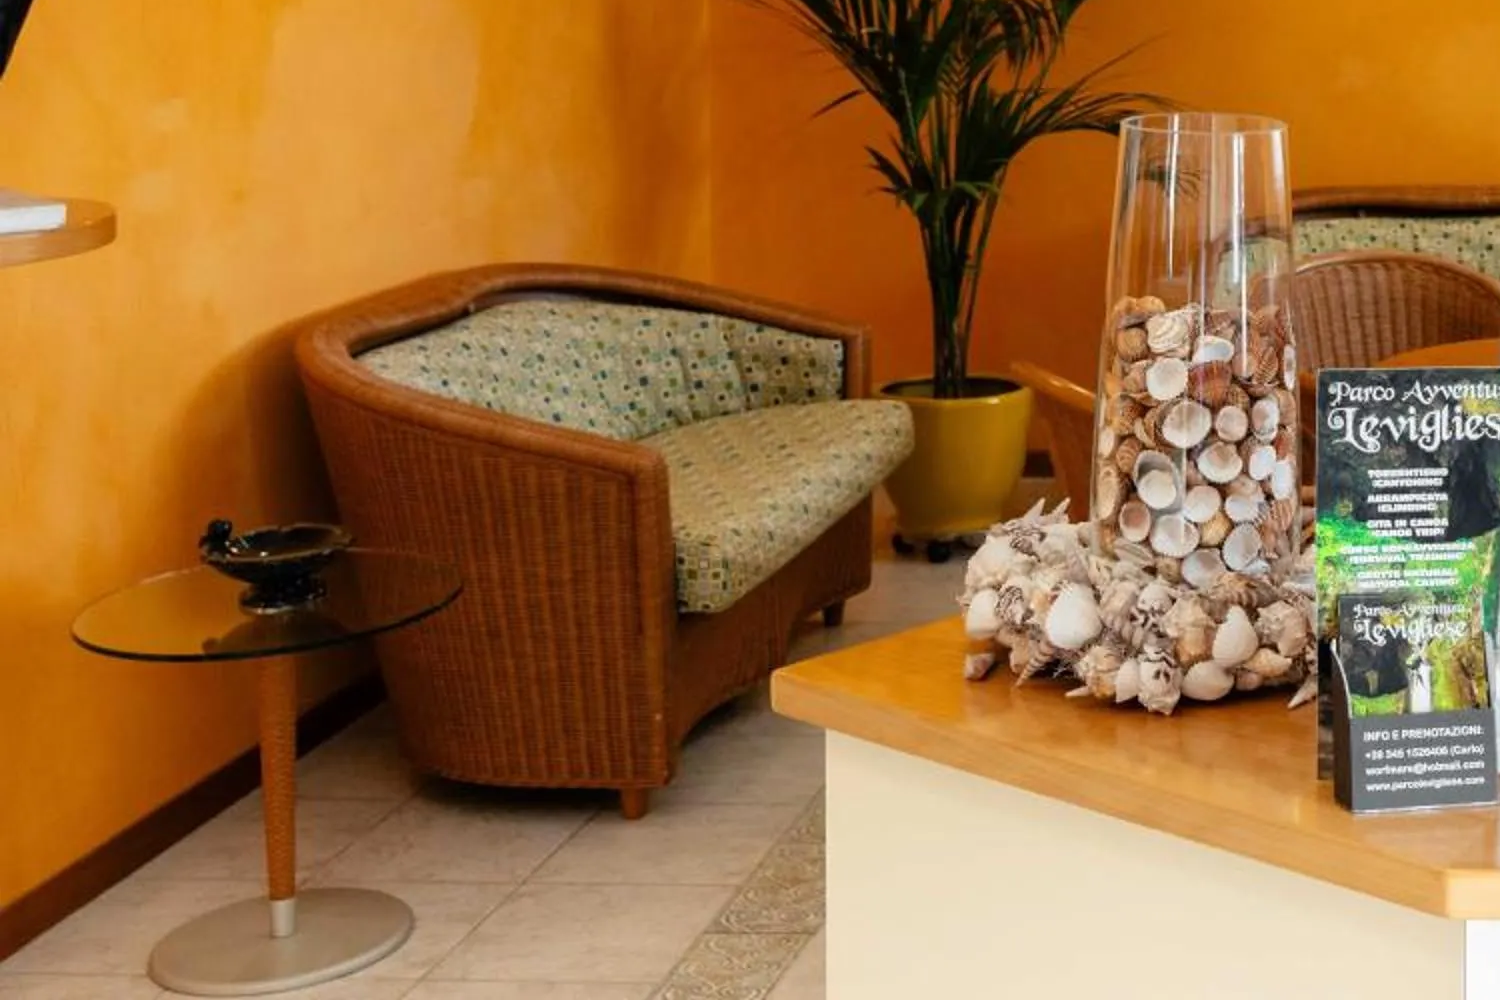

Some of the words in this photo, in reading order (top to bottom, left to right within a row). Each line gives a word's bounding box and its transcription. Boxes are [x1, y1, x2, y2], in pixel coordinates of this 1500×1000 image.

[1328, 381, 1395, 406] Parco
[1363, 730, 1390, 742] INFO
[1392, 729, 1400, 741] E
